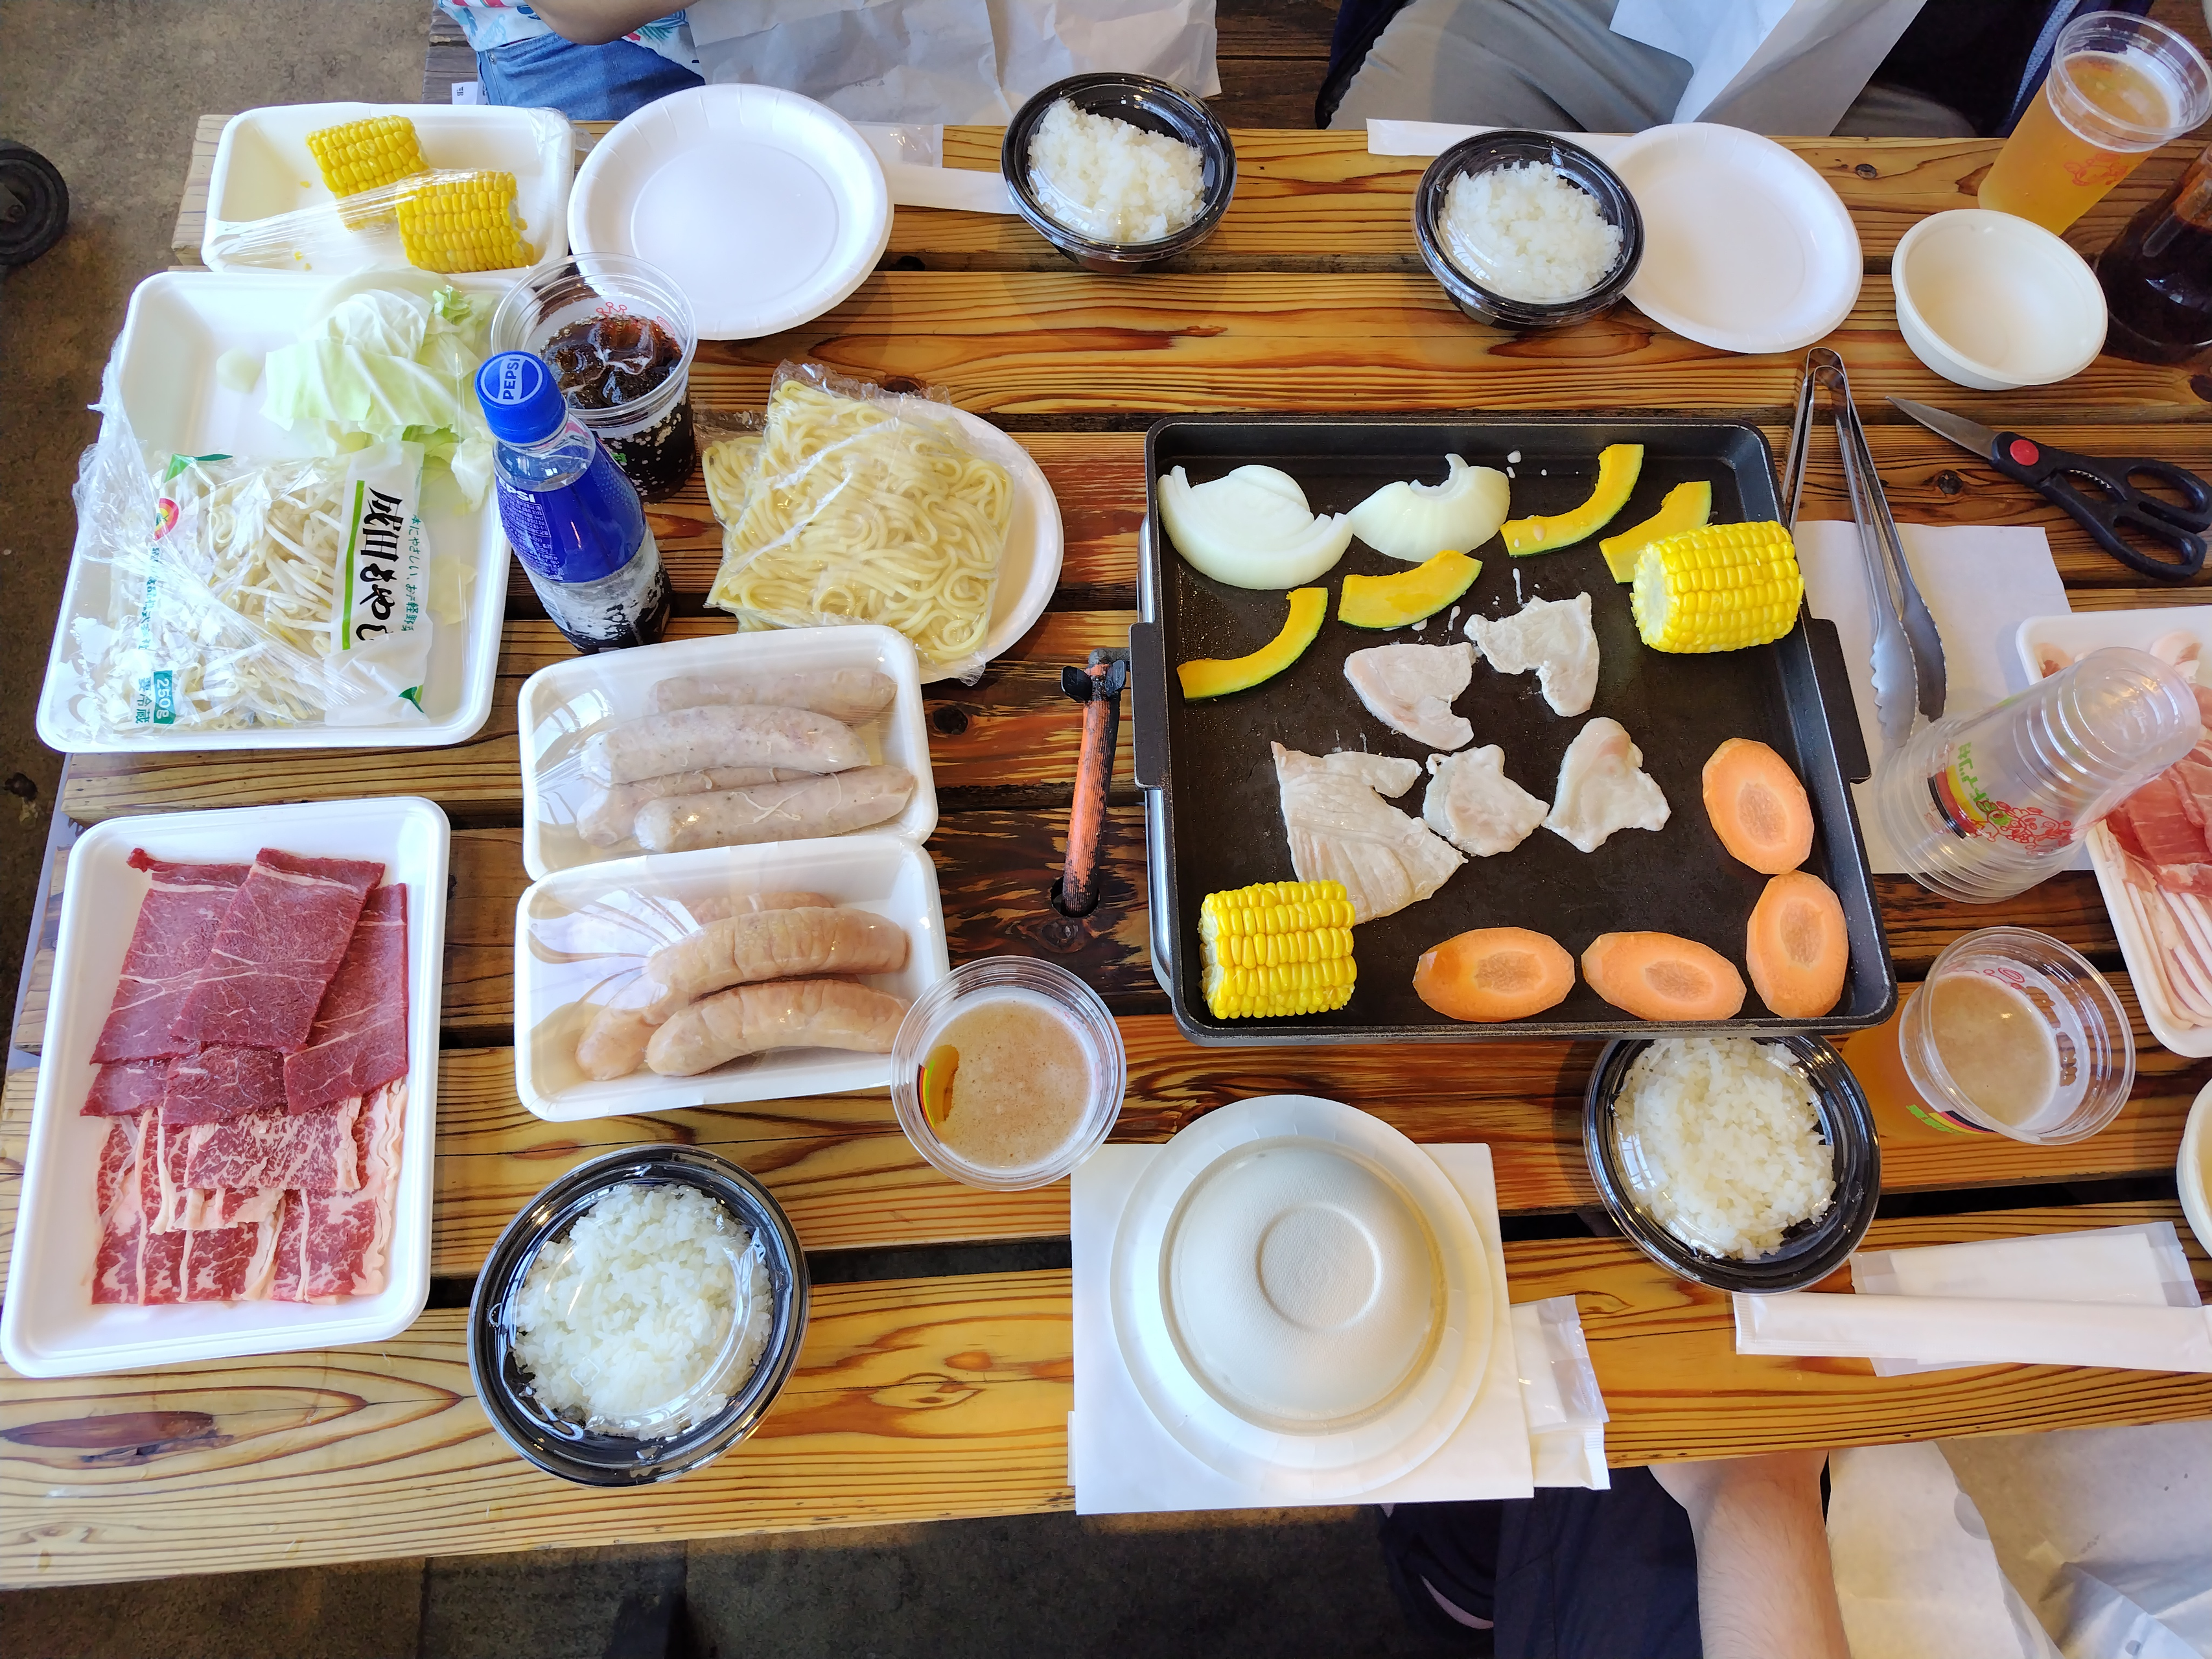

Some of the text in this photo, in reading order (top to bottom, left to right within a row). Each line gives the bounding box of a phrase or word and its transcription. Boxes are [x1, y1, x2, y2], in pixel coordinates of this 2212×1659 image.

[503, 358, 520, 400] PEPSI
[495, 471, 536, 503] EPSI
[356, 487, 404, 641] 成田もやし
[135, 676, 153, 725] 要冷蔵
[156, 678, 171, 719] 250g
